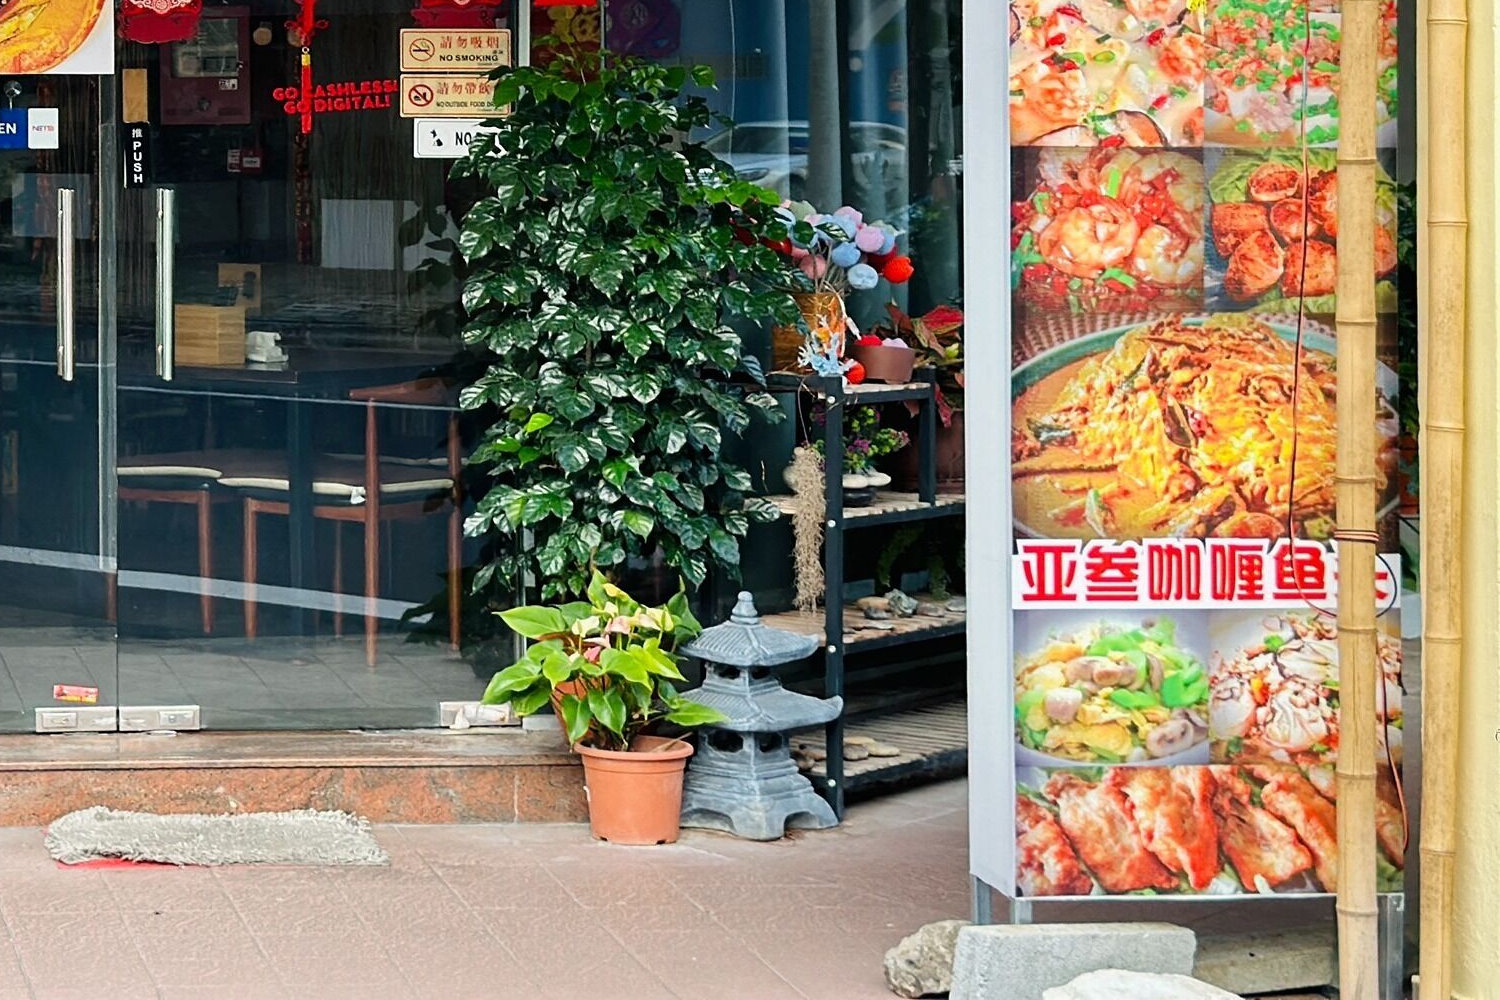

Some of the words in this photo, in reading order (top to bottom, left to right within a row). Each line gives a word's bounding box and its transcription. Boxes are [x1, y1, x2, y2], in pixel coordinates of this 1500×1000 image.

[439, 54, 453, 62] NO
[455, 54, 499, 62] SMOKING
[273, 87, 299, 100] GO
[304, 80, 398, 98] ASHLESS!
[284, 100, 311, 114] GO
[314, 95, 391, 112] DIGITAL!
[132, 128, 143, 138] 推
[455, 132, 472, 145] NO
[133, 141, 143, 184] PUSH
[1022, 543, 1389, 602] 亚叁咖喱鱼
